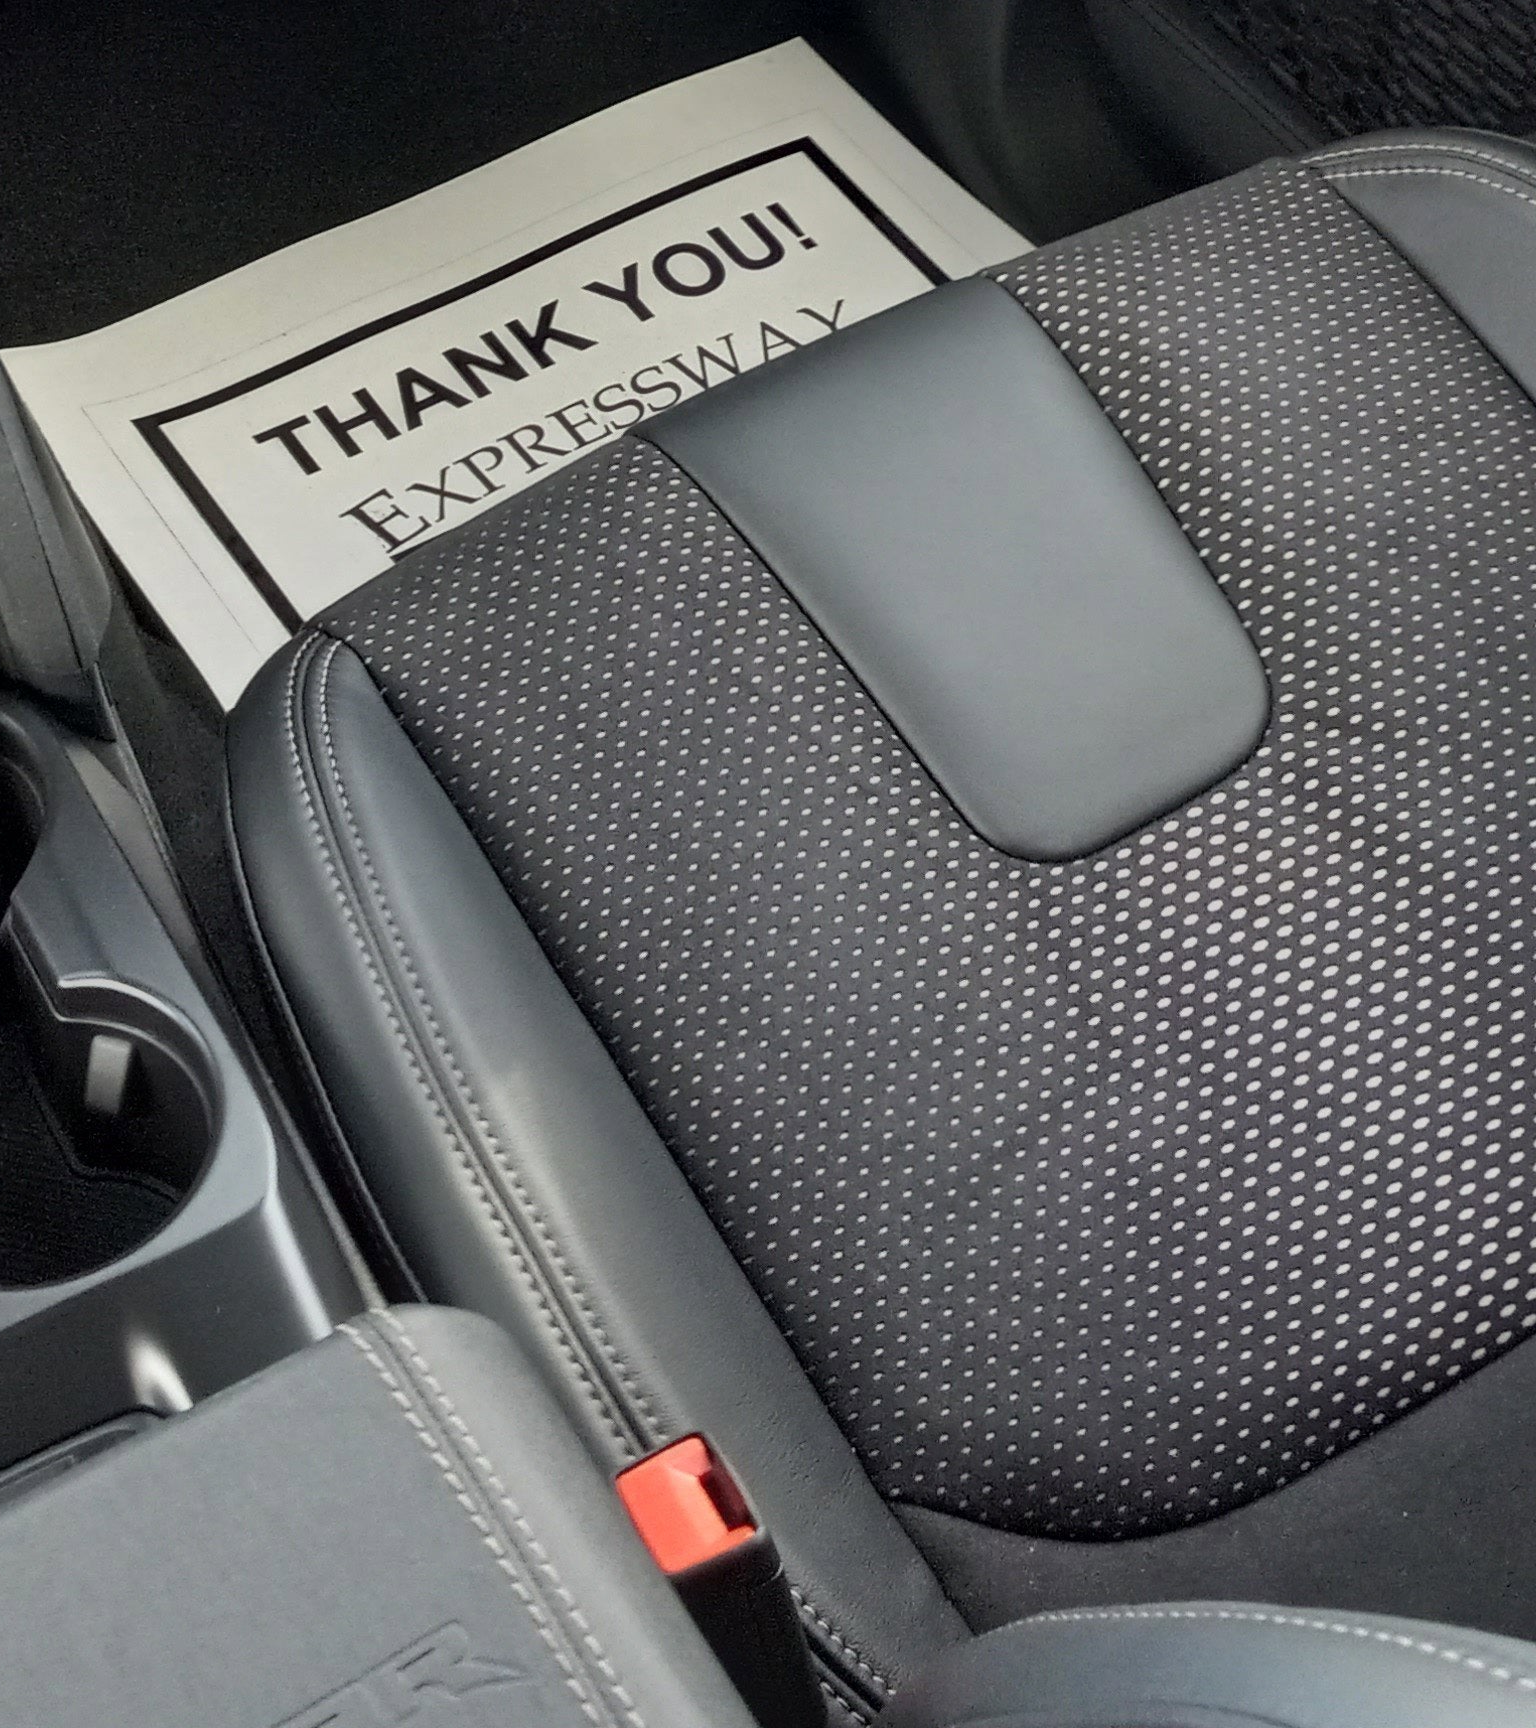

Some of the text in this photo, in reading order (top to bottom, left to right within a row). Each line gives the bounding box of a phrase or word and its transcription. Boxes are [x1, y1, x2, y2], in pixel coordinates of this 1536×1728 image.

[252, 202, 817, 477] THANK YOU!
[338, 298, 845, 555] EXPRESSWAY
